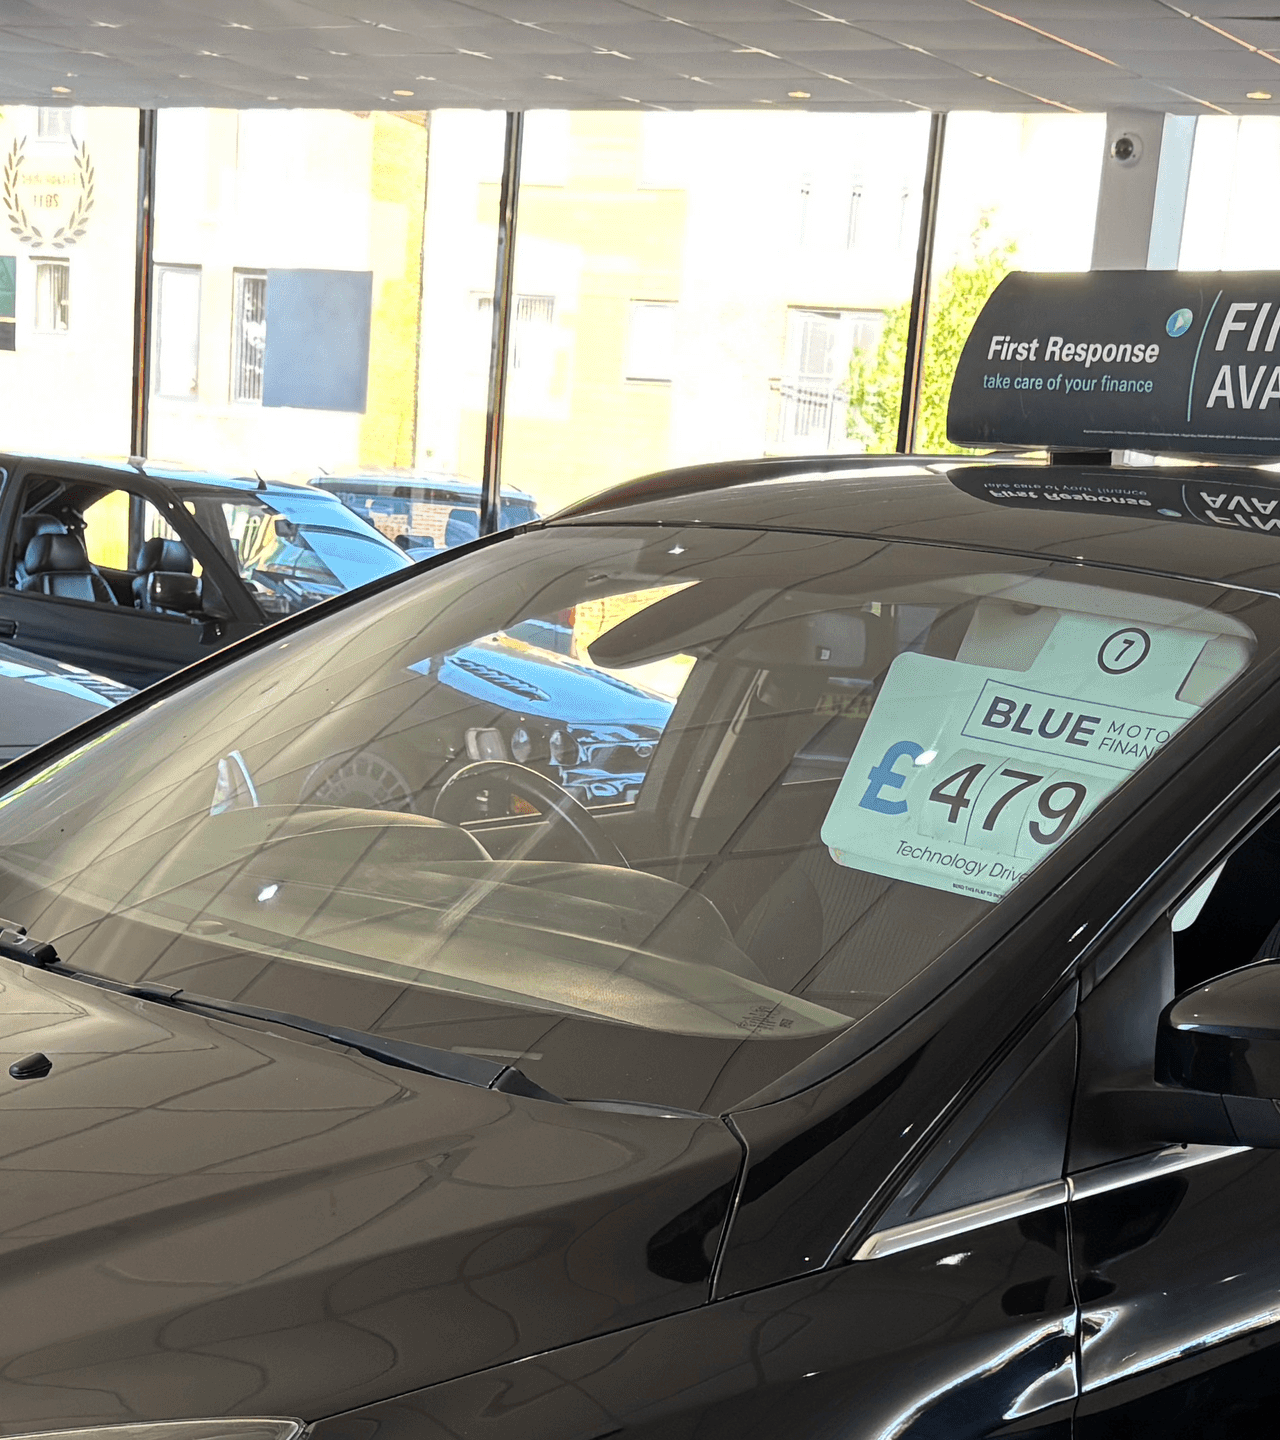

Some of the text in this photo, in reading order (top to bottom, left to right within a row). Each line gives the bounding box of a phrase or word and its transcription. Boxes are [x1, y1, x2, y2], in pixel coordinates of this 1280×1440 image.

[987, 335, 1160, 369] First Response
[983, 373, 1154, 394] take care of your finance
[1113, 638, 1136, 663] 7
[981, 695, 1102, 747] BLUE
[1098, 737, 1159, 761] FINAN
[896, 840, 988, 877] Technology
